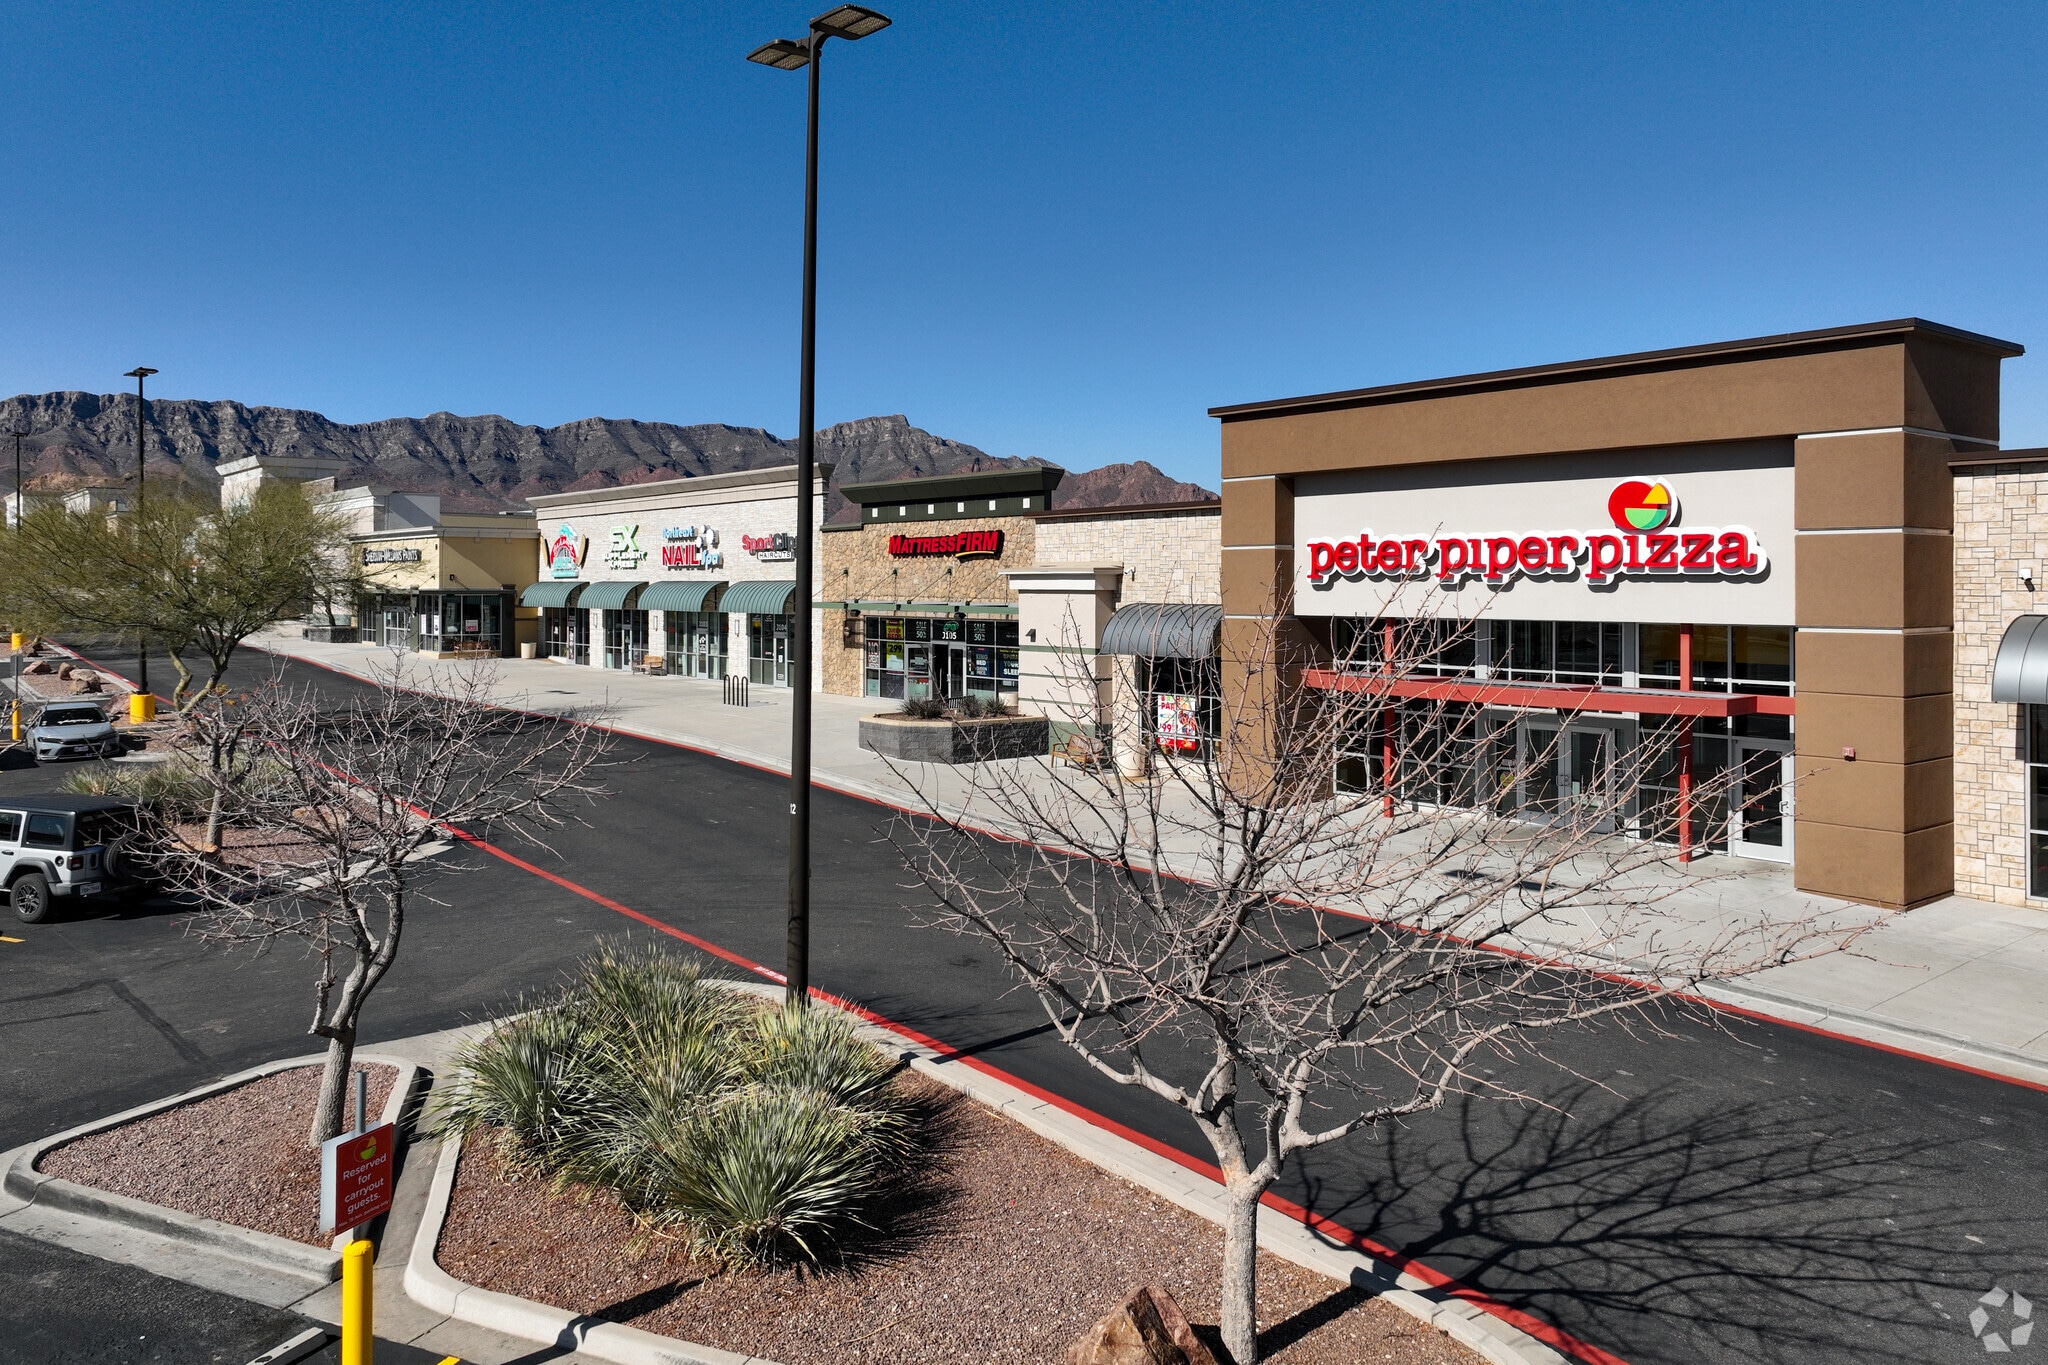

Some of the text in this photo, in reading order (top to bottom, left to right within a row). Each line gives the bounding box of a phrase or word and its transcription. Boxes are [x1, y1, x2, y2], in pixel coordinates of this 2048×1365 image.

[662, 545, 699, 565] NAIL
[1307, 531, 1758, 579] peter piper pizza
[343, 1153, 387, 1180] Reserved
[344, 1178, 384, 1203] carryout
[357, 1173, 372, 1185] for
[347, 1193, 381, 1215] guests.
